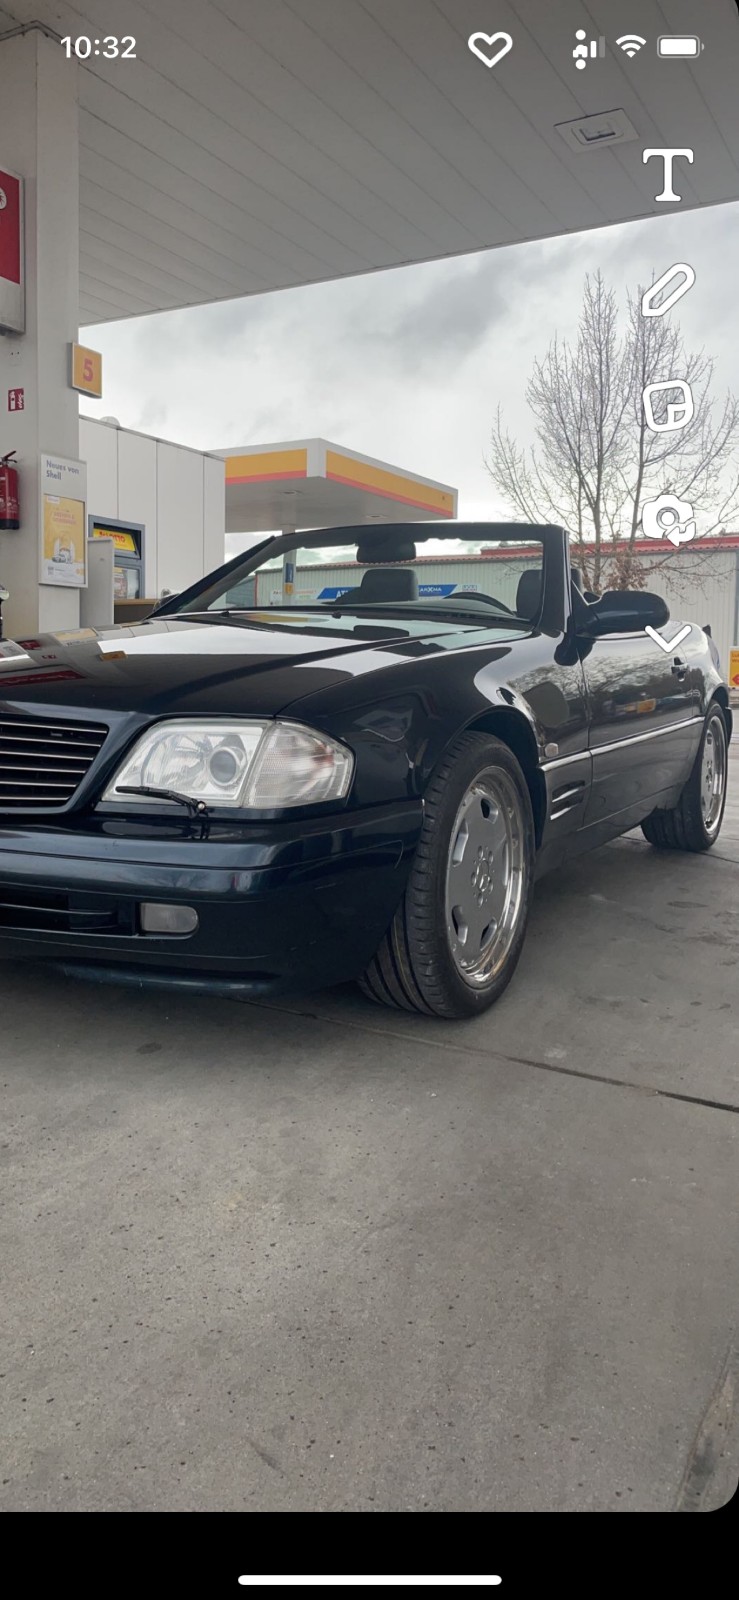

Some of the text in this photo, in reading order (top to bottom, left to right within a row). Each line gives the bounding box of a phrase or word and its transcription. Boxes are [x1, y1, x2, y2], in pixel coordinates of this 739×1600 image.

[82, 358, 94, 382] 5
[46, 459, 80, 475] Neues von
[46, 469, 62, 481] Shell
